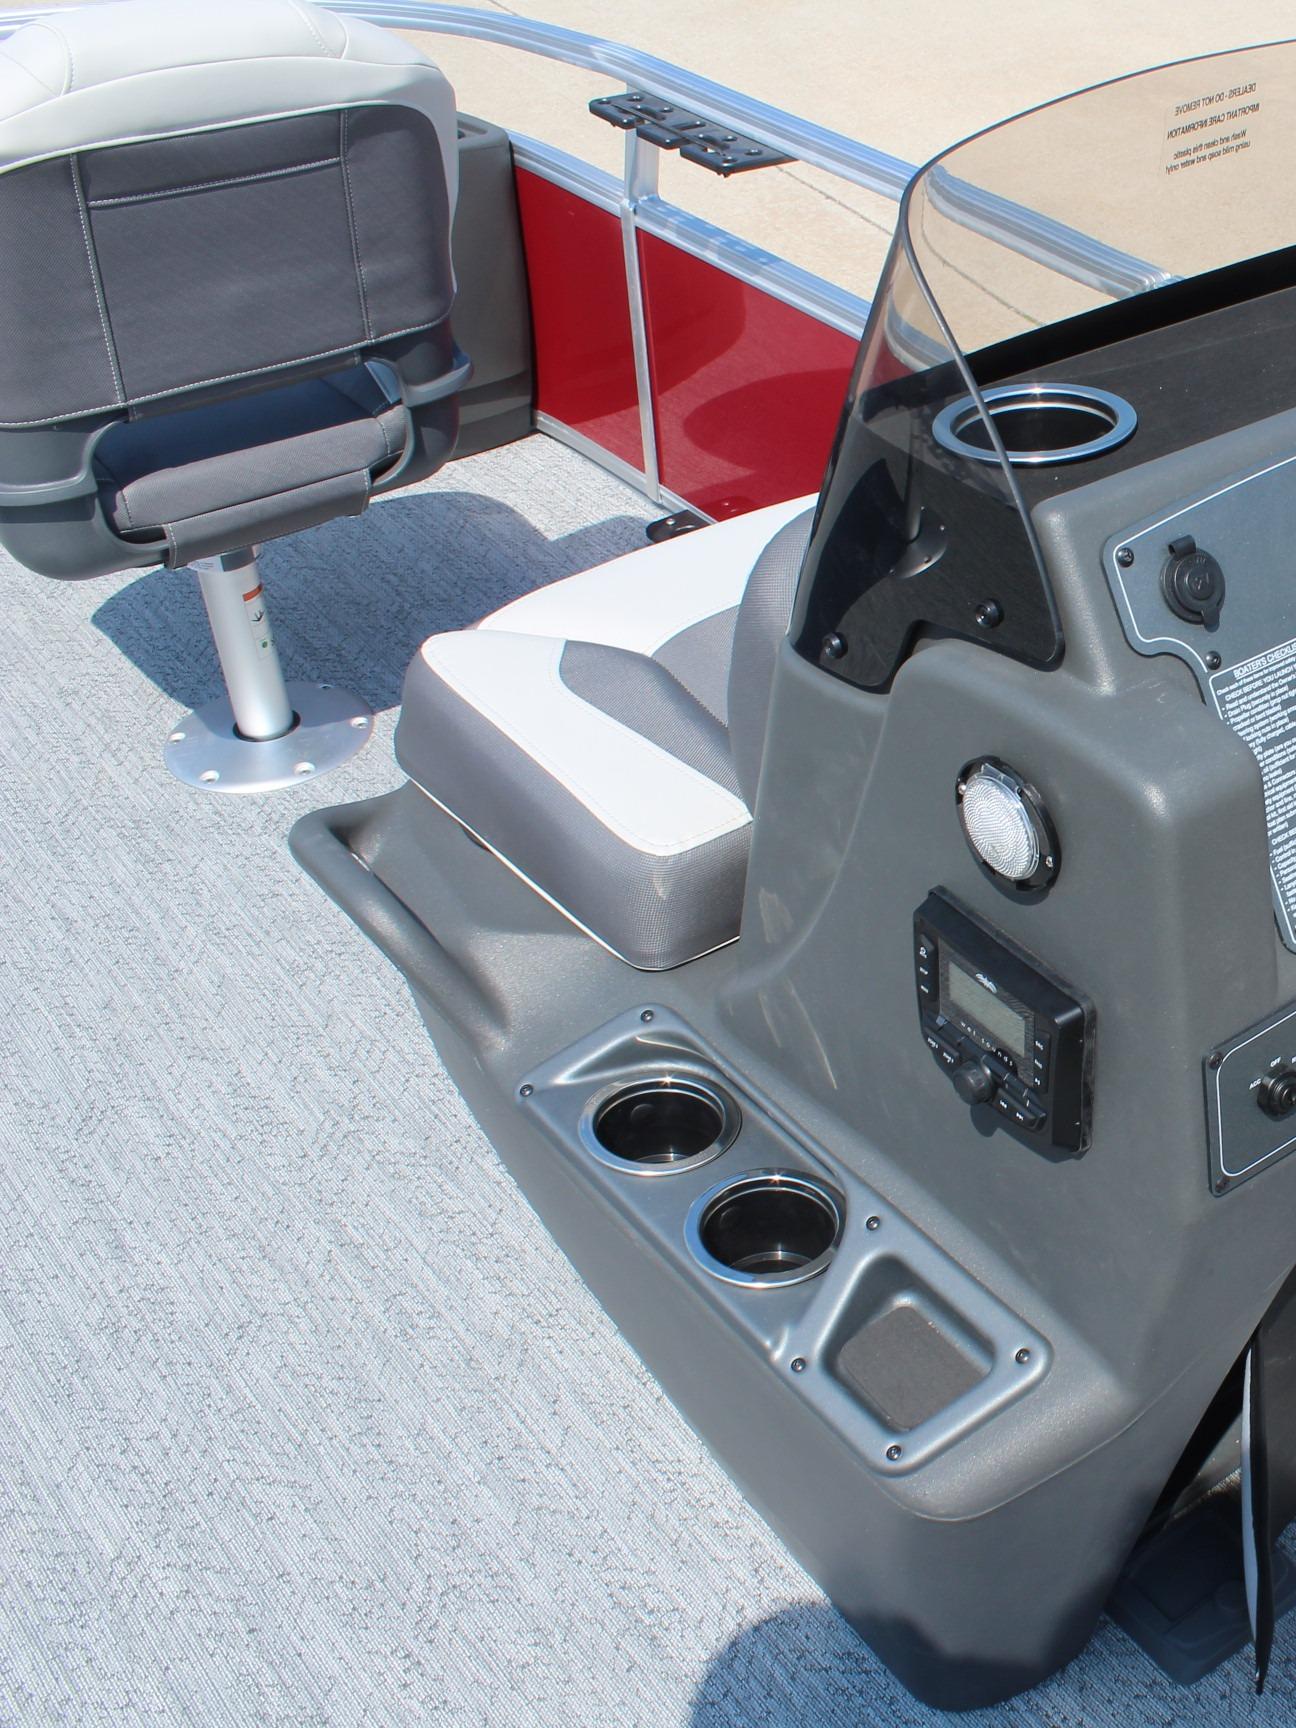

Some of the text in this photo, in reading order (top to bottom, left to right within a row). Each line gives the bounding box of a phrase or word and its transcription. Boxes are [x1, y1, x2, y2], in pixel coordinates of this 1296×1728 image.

[1232, 656, 1267, 678] BOATER'S
[1224, 687, 1243, 701] CHECK
[1242, 678, 1263, 693] BEFORE
[1262, 673, 1274, 684] YOU
[1249, 1078, 1261, 1089] ACC
